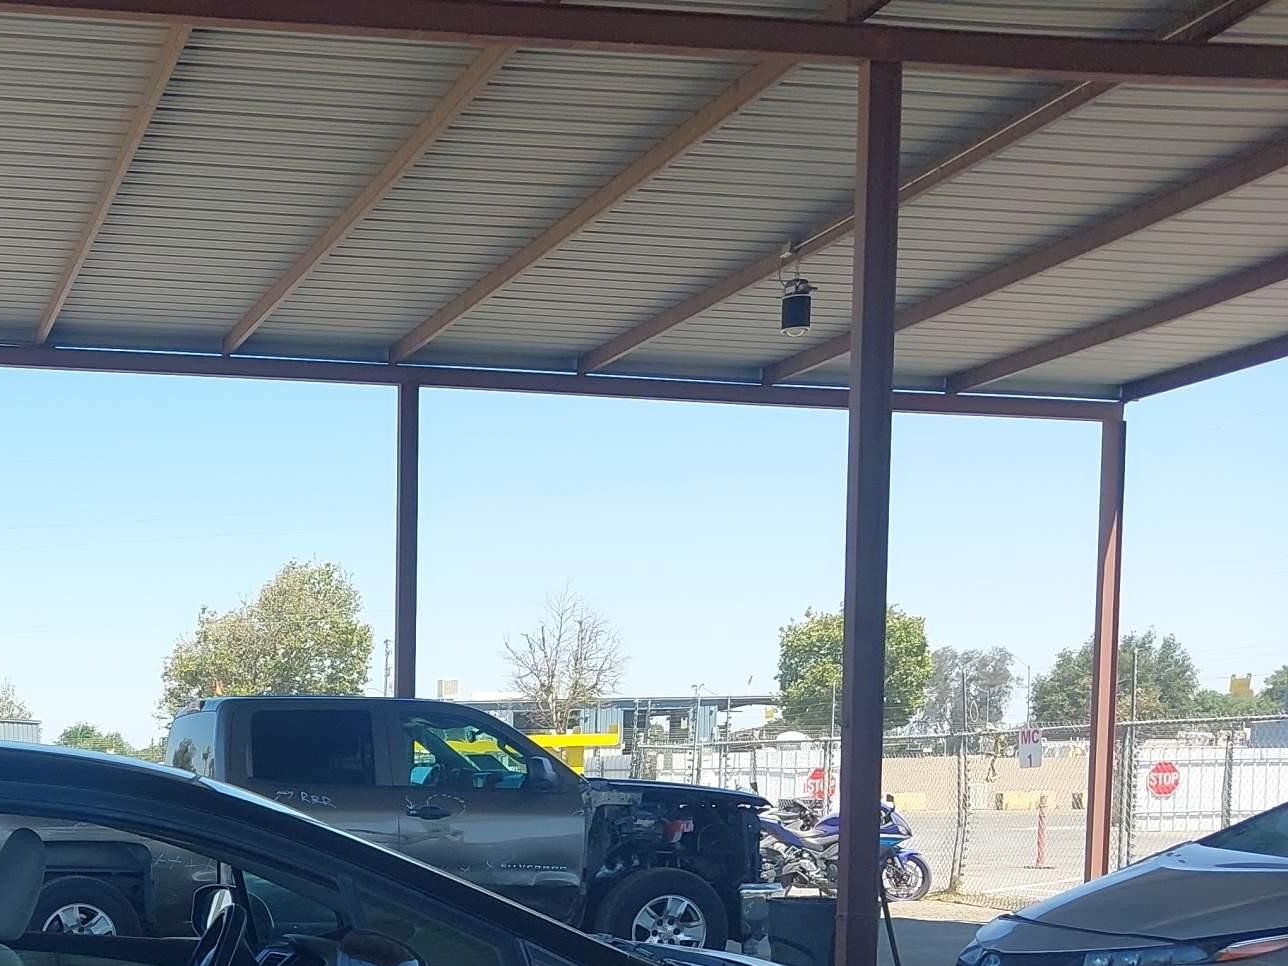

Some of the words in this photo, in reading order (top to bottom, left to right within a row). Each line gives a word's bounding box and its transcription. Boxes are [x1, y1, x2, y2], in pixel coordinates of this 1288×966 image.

[1021, 729, 1040, 744] MC
[1027, 753, 1033, 768] 1
[1149, 772, 1179, 785] STOP
